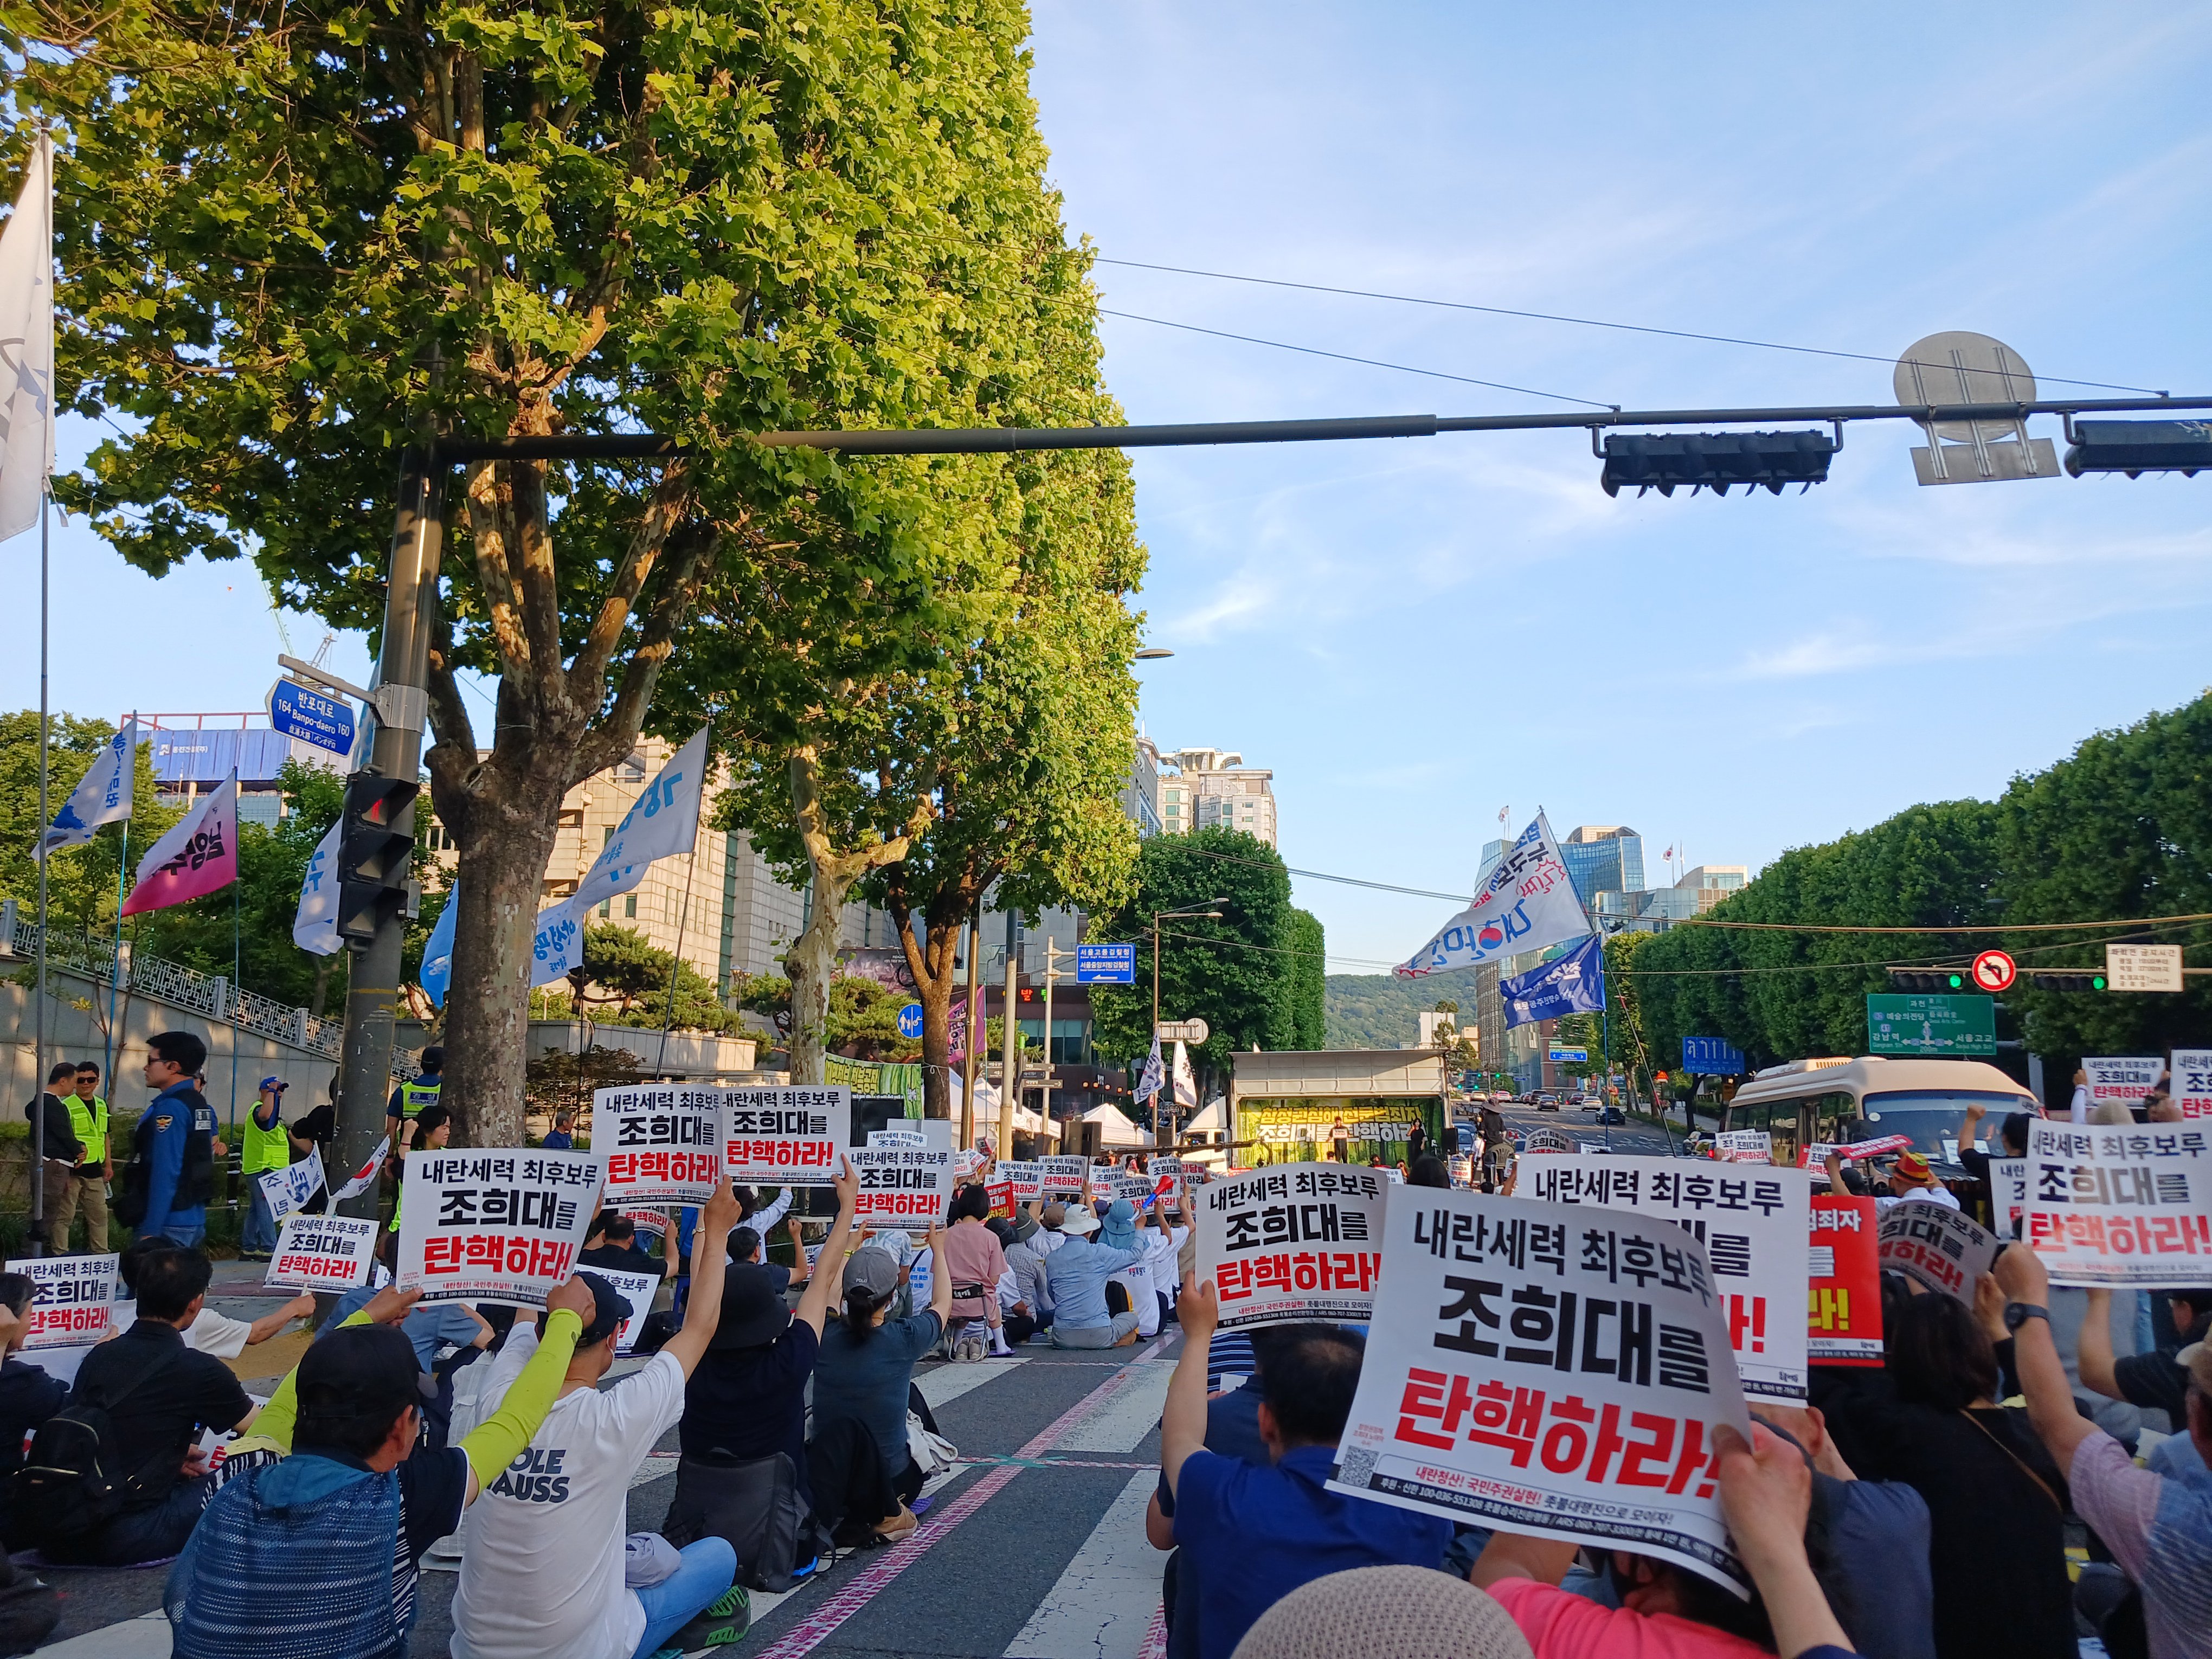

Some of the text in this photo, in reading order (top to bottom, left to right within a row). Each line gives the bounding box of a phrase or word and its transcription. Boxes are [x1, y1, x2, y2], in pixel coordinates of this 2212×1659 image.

[298, 691, 334, 718] 반포대로
[278, 699, 350, 737] 164 Banpo-daero 160
[1886, 1012, 1925, 1020] 예술의전당
[1872, 1033, 1900, 1041] 강남역
[1956, 1033, 1994, 1043] 서울고교
[2097, 1071, 2150, 1083] 조희대를
[606, 1091, 719, 1113] 내란세력 최후보루
[723, 1092, 777, 1108] 내란세력
[783, 1091, 840, 1108] 최후보루
[618, 1115, 715, 1146] 조희대를
[734, 1110, 827, 1135] 조희대를
[727, 1140, 833, 1166] 탄핵하라!
[851, 1152, 948, 1166] 내란세력 최후보루
[2101, 1133, 2207, 1161] 최후보루
[422, 1158, 599, 1189] 내란세력 최후보루
[608, 1152, 718, 1185] 탄핵하라!
[860, 1168, 937, 1189] 조희대를
[1004, 1171, 1038, 1182] 조희대를
[1044, 1176, 1082, 1186] 탄핵하라!
[1046, 1165, 1080, 1175] 조희대를
[1095, 1173, 1123, 1182] 조희대를
[2000, 1165, 2025, 1177] 내란
[1012, 1184, 1038, 1194] 핵하라!
[1119, 1187, 1152, 1199] 조희대를
[1210, 1172, 1380, 1211] 내란세력 최후보루
[1535, 1168, 1784, 1217] 내란세력 최후보루
[2038, 1163, 2191, 1205] 조희대를
[438, 1188, 578, 1231] 조희대를
[854, 1193, 941, 1216] 탄핵하라!
[290, 1219, 370, 1236] 내란세력 최후보루
[625, 1211, 667, 1229] 탄핵하라!
[1225, 1203, 1369, 1252] 조희대를
[288, 1233, 356, 1255] 조희대를
[1879, 1219, 1964, 1261] 희대를
[2030, 1212, 2212, 1255] 탄핵하라!
[18, 1259, 115, 1279] 내란세력 최후보루
[277, 1255, 357, 1279] 탄핵하라!
[424, 1235, 574, 1281] 탄핵하라!
[1414, 1209, 1566, 1276] 내란세력
[1581, 1229, 1713, 1307] 최후보루
[1879, 1240, 1964, 1293] 하라!
[600, 1274, 648, 1293] 후보루
[1216, 1252, 1381, 1302] 탄핵하라!
[33, 1279, 108, 1305] 조희대를
[29, 1306, 109, 1334] 탄핵하라!
[1433, 1275, 1711, 1394] 조희대를
[1394, 1366, 1721, 1499] 탄핵하라!
[486, 1470, 570, 1503] AUSS
[1416, 1465, 1674, 1525] 내란청산! 국민주권실현! 촛불대행진으로 모이자!
